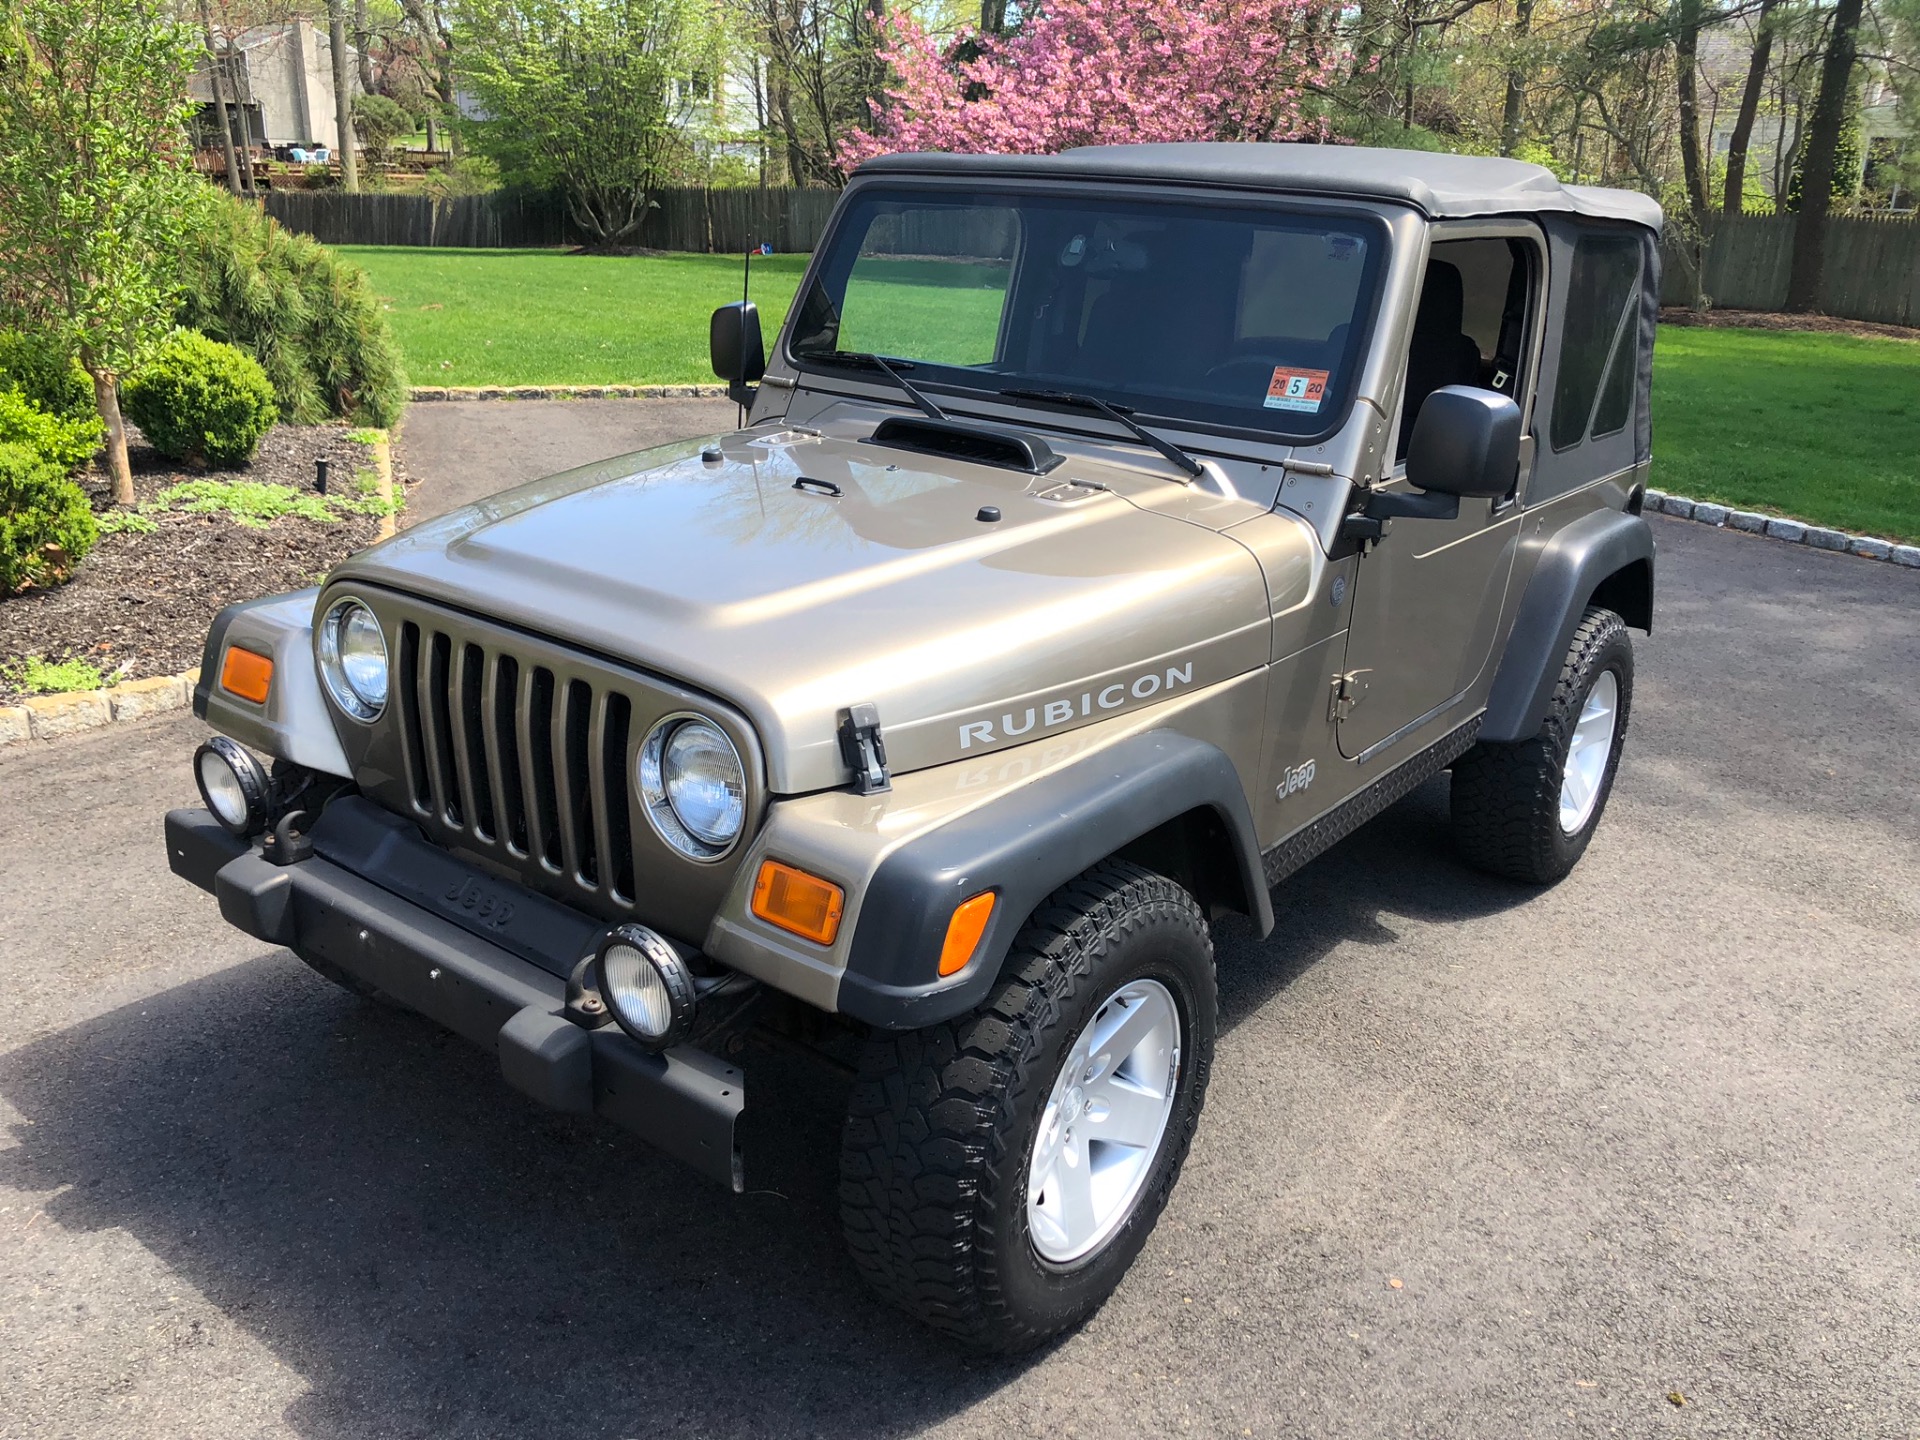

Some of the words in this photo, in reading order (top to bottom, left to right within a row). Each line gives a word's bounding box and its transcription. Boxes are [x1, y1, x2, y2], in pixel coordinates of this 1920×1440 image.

[1273, 379, 1286, 389] 20
[1291, 379, 1302, 394] 5
[1308, 383, 1322, 394] 20
[959, 662, 1193, 749] RUBICON
[1276, 758, 1315, 799] Jeep
[445, 873, 514, 927] Jeep
